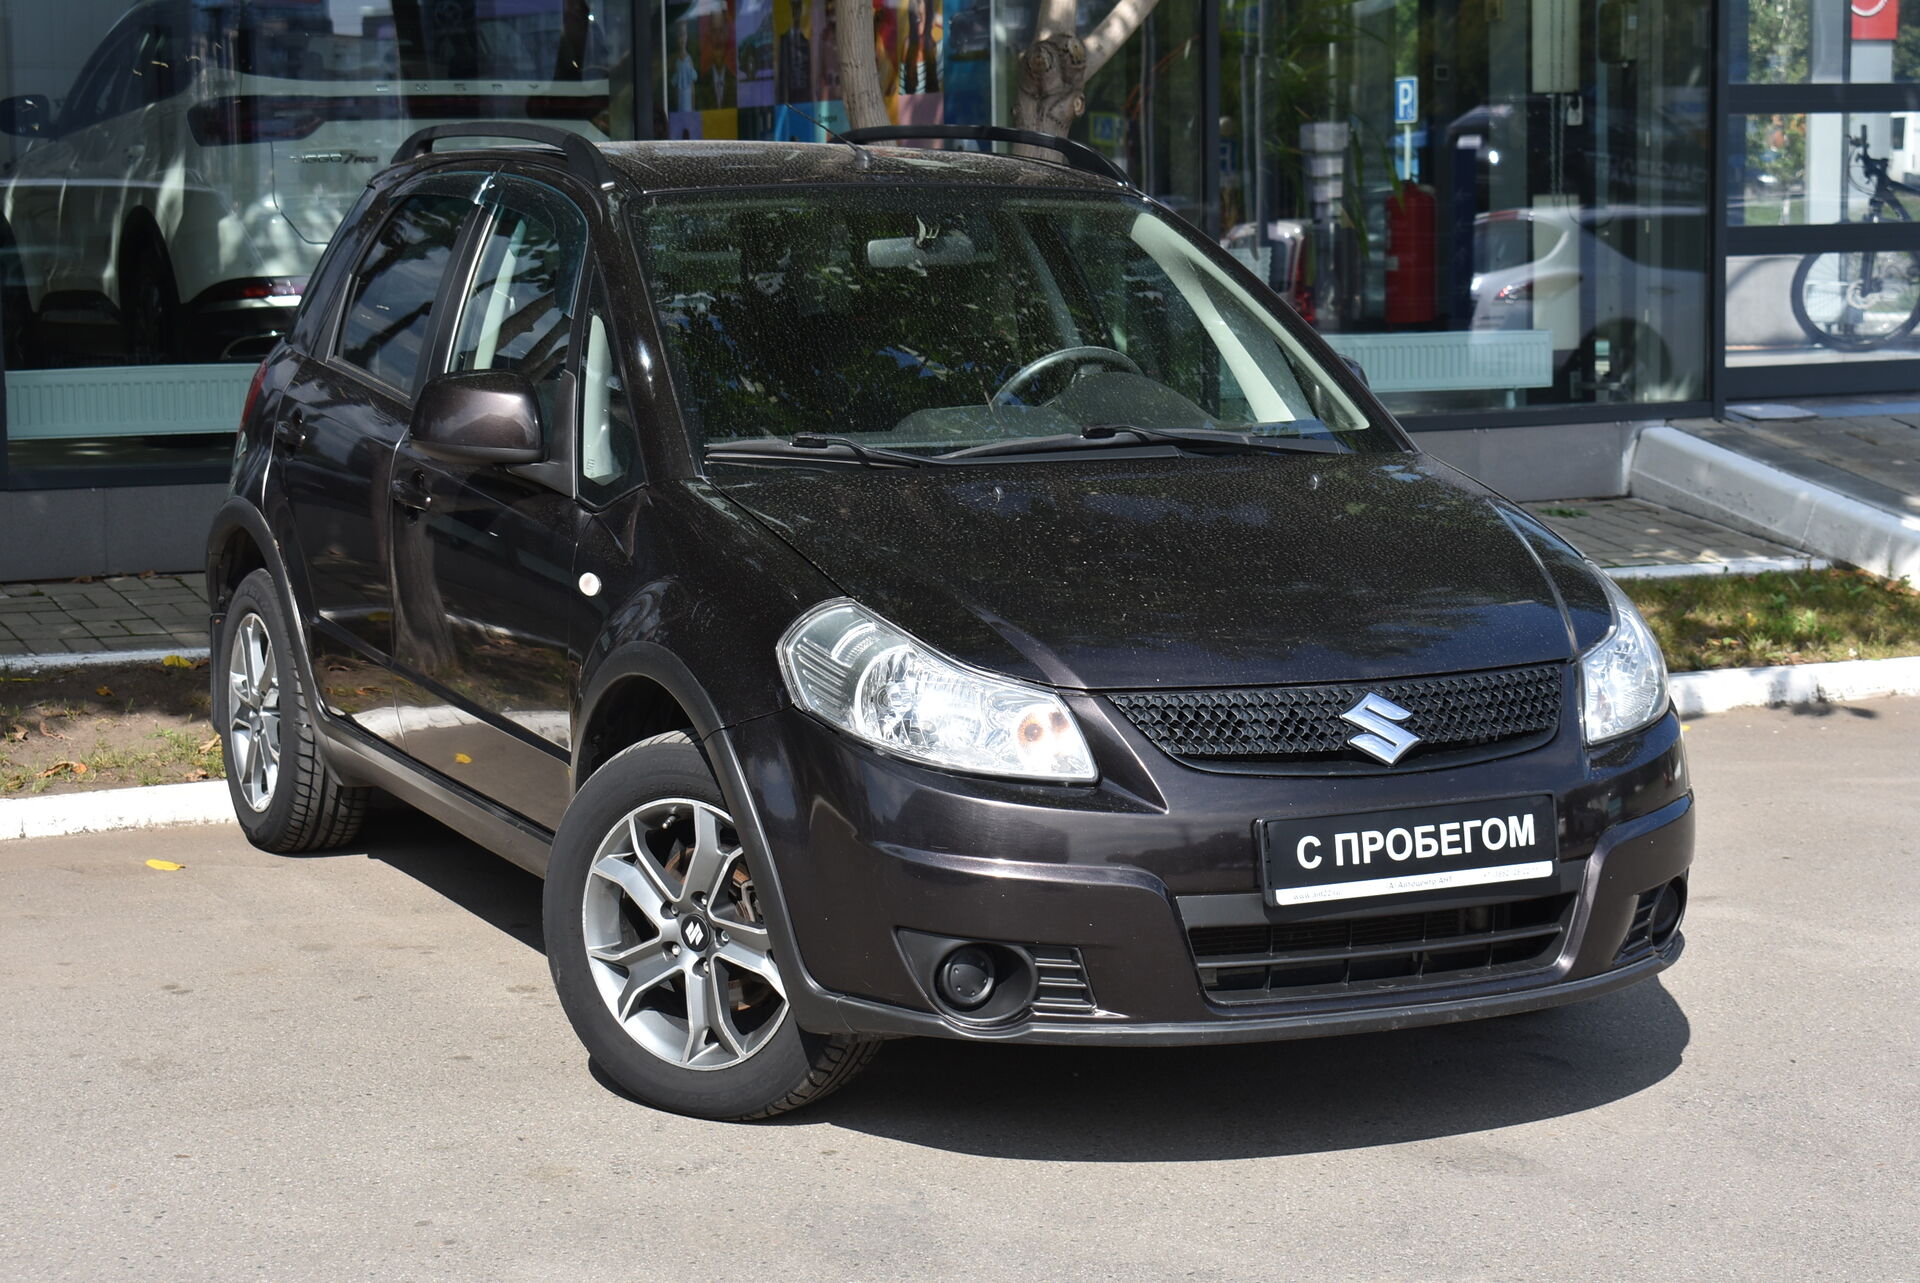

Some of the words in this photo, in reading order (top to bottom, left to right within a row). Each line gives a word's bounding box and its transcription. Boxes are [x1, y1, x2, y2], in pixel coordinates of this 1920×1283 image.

[1398, 82, 1413, 118] P
[1296, 835, 1323, 870] С
[1334, 813, 1536, 867] ПРОБЕГОМ
